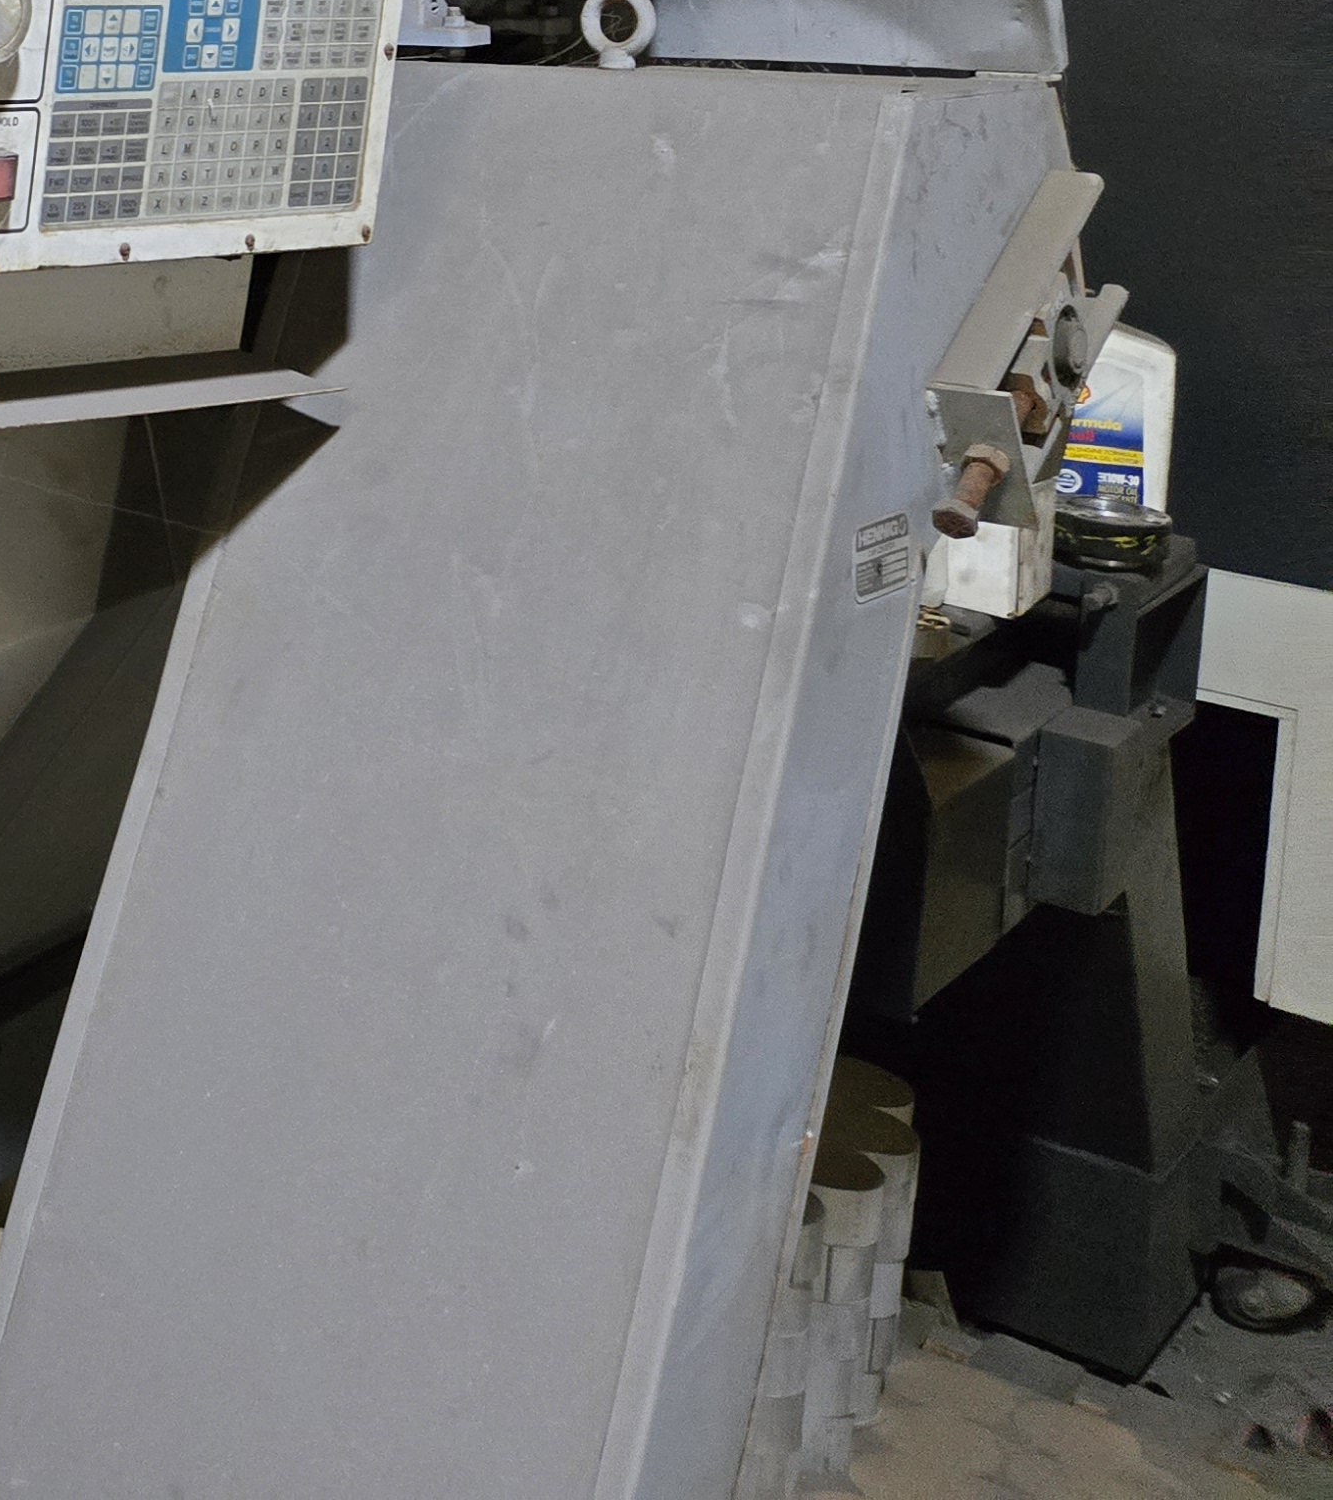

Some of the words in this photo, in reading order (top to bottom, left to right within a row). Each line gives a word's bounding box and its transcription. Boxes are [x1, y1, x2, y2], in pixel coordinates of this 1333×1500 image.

[190, 89, 196, 99] A
[214, 88, 221, 98] B
[237, 87, 244, 98] C
[259, 87, 266, 97] D
[282, 86, 288, 96] E
[165, 117, 171, 127] F
[187, 116, 194, 126] G
[279, 113, 286, 124] K
[161, 144, 167, 155] L
[184, 143, 191, 153] M
[253, 140, 259, 150] P
[275, 139, 282, 150] Q
[157, 172, 164, 182] R
[181, 170, 188, 181] S
[205, 169, 211, 178] T
[227, 168, 234, 178] U
[154, 199, 161, 208] X
[179, 197, 185, 207] Y
[201, 196, 208, 206] Z
[1098, 484, 1124, 494] MOTOR
[858, 519, 899, 548] HENNIG
